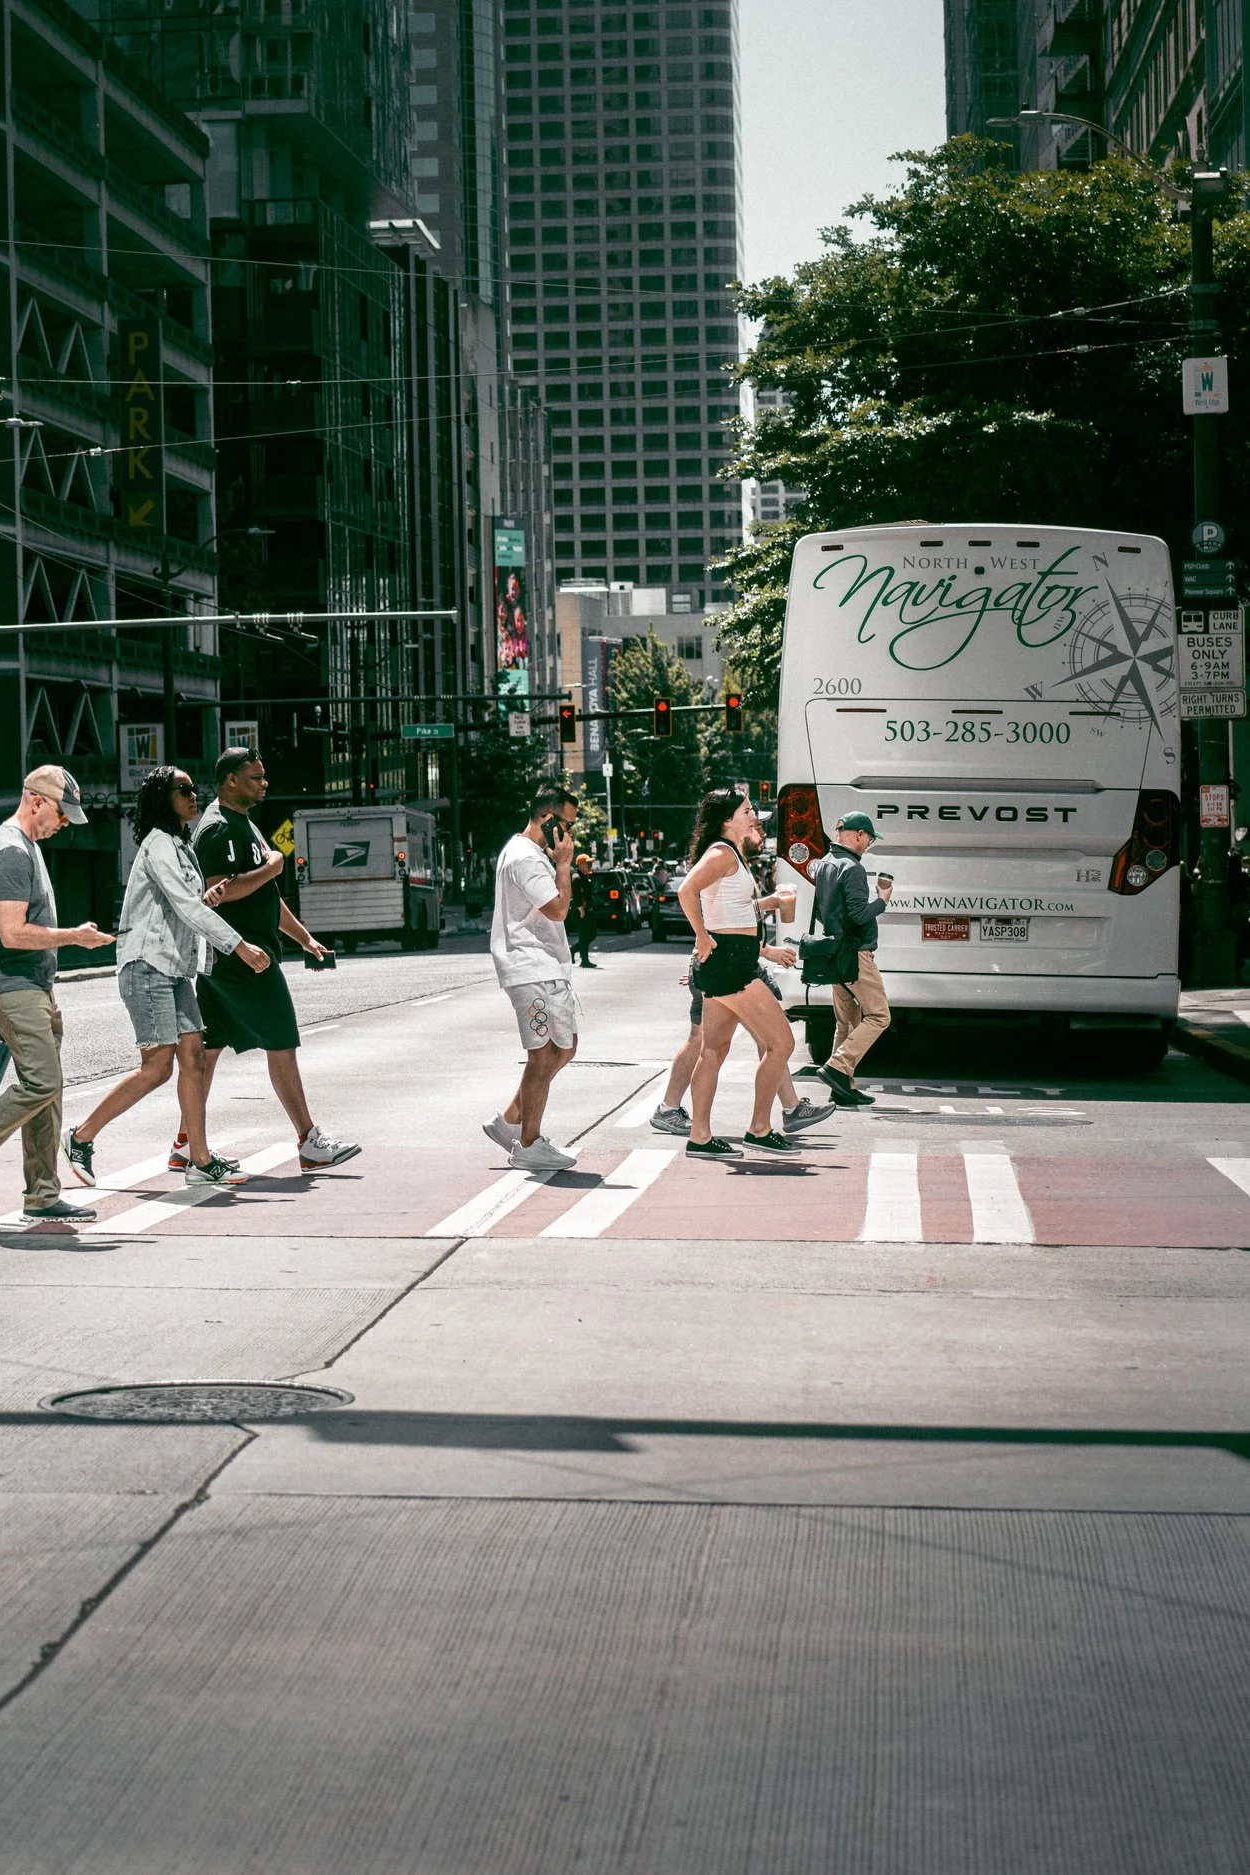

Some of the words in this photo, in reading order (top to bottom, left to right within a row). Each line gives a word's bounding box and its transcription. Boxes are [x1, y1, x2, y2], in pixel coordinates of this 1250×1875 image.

[125, 331, 156, 479] PARK
[1203, 526, 1218, 549] P
[902, 556, 968, 569] NORTH
[990, 556, 1040, 570] WEST
[1091, 552, 1109, 571] N
[813, 546, 1099, 671] Navigator
[1213, 612, 1239, 620] CURB
[1213, 622, 1238, 630] LANE
[1187, 637, 1232, 647] BUSES
[1192, 649, 1227, 659] ONLY
[588, 657, 598, 686] HALL
[813, 677, 862, 695] 2600
[1023, 681, 1044, 700] W
[1182, 695, 1207, 704] RIGHT
[1211, 694, 1239, 703] TURNS
[589, 687, 600, 751] BENAOYA
[1187, 705, 1236, 715] PERMITTED
[884, 720, 1071, 744] 503-285-3000
[876, 804, 1078, 823] PREVOST
[948, 924, 968, 932] CARRIER
[982, 926, 1026, 937] YASP308
